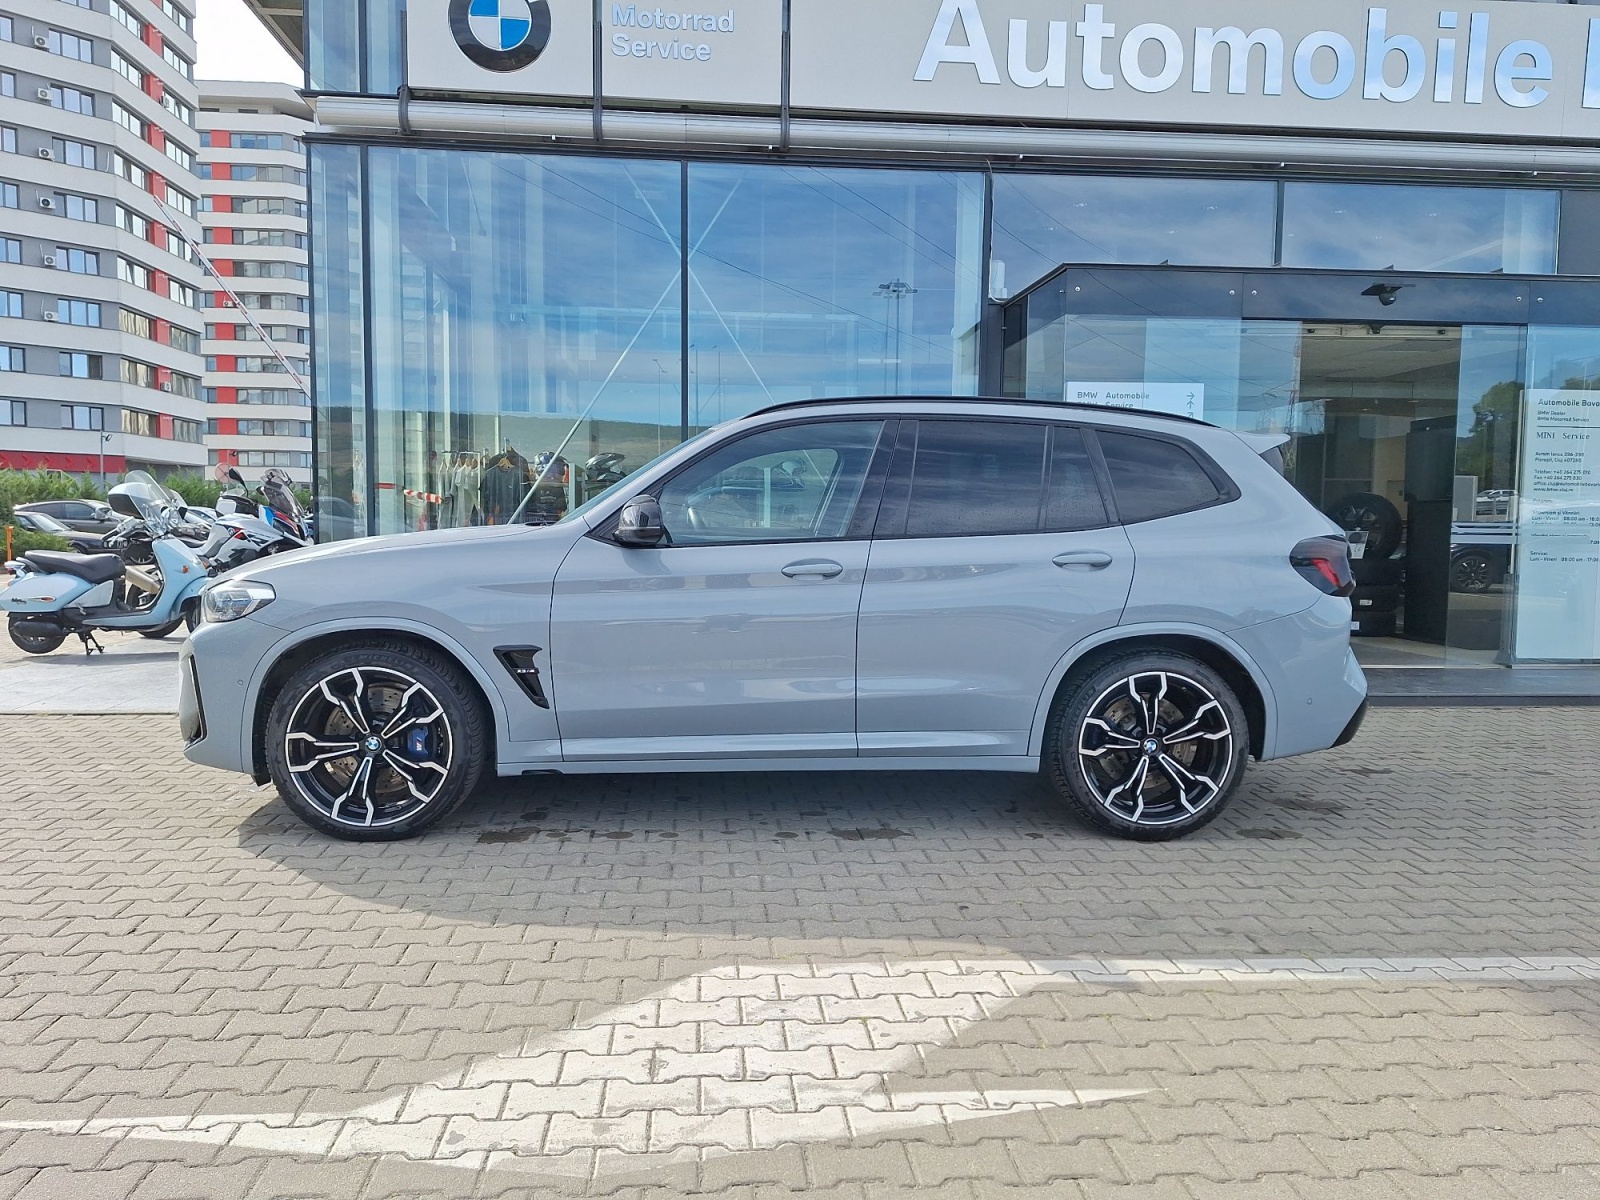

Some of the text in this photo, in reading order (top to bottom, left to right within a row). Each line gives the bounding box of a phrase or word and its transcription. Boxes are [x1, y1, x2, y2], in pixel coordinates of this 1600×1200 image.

[612, 3, 734, 32] Motorrad
[611, 33, 711, 61] Service
[913, 0, 1553, 108] Automobile
